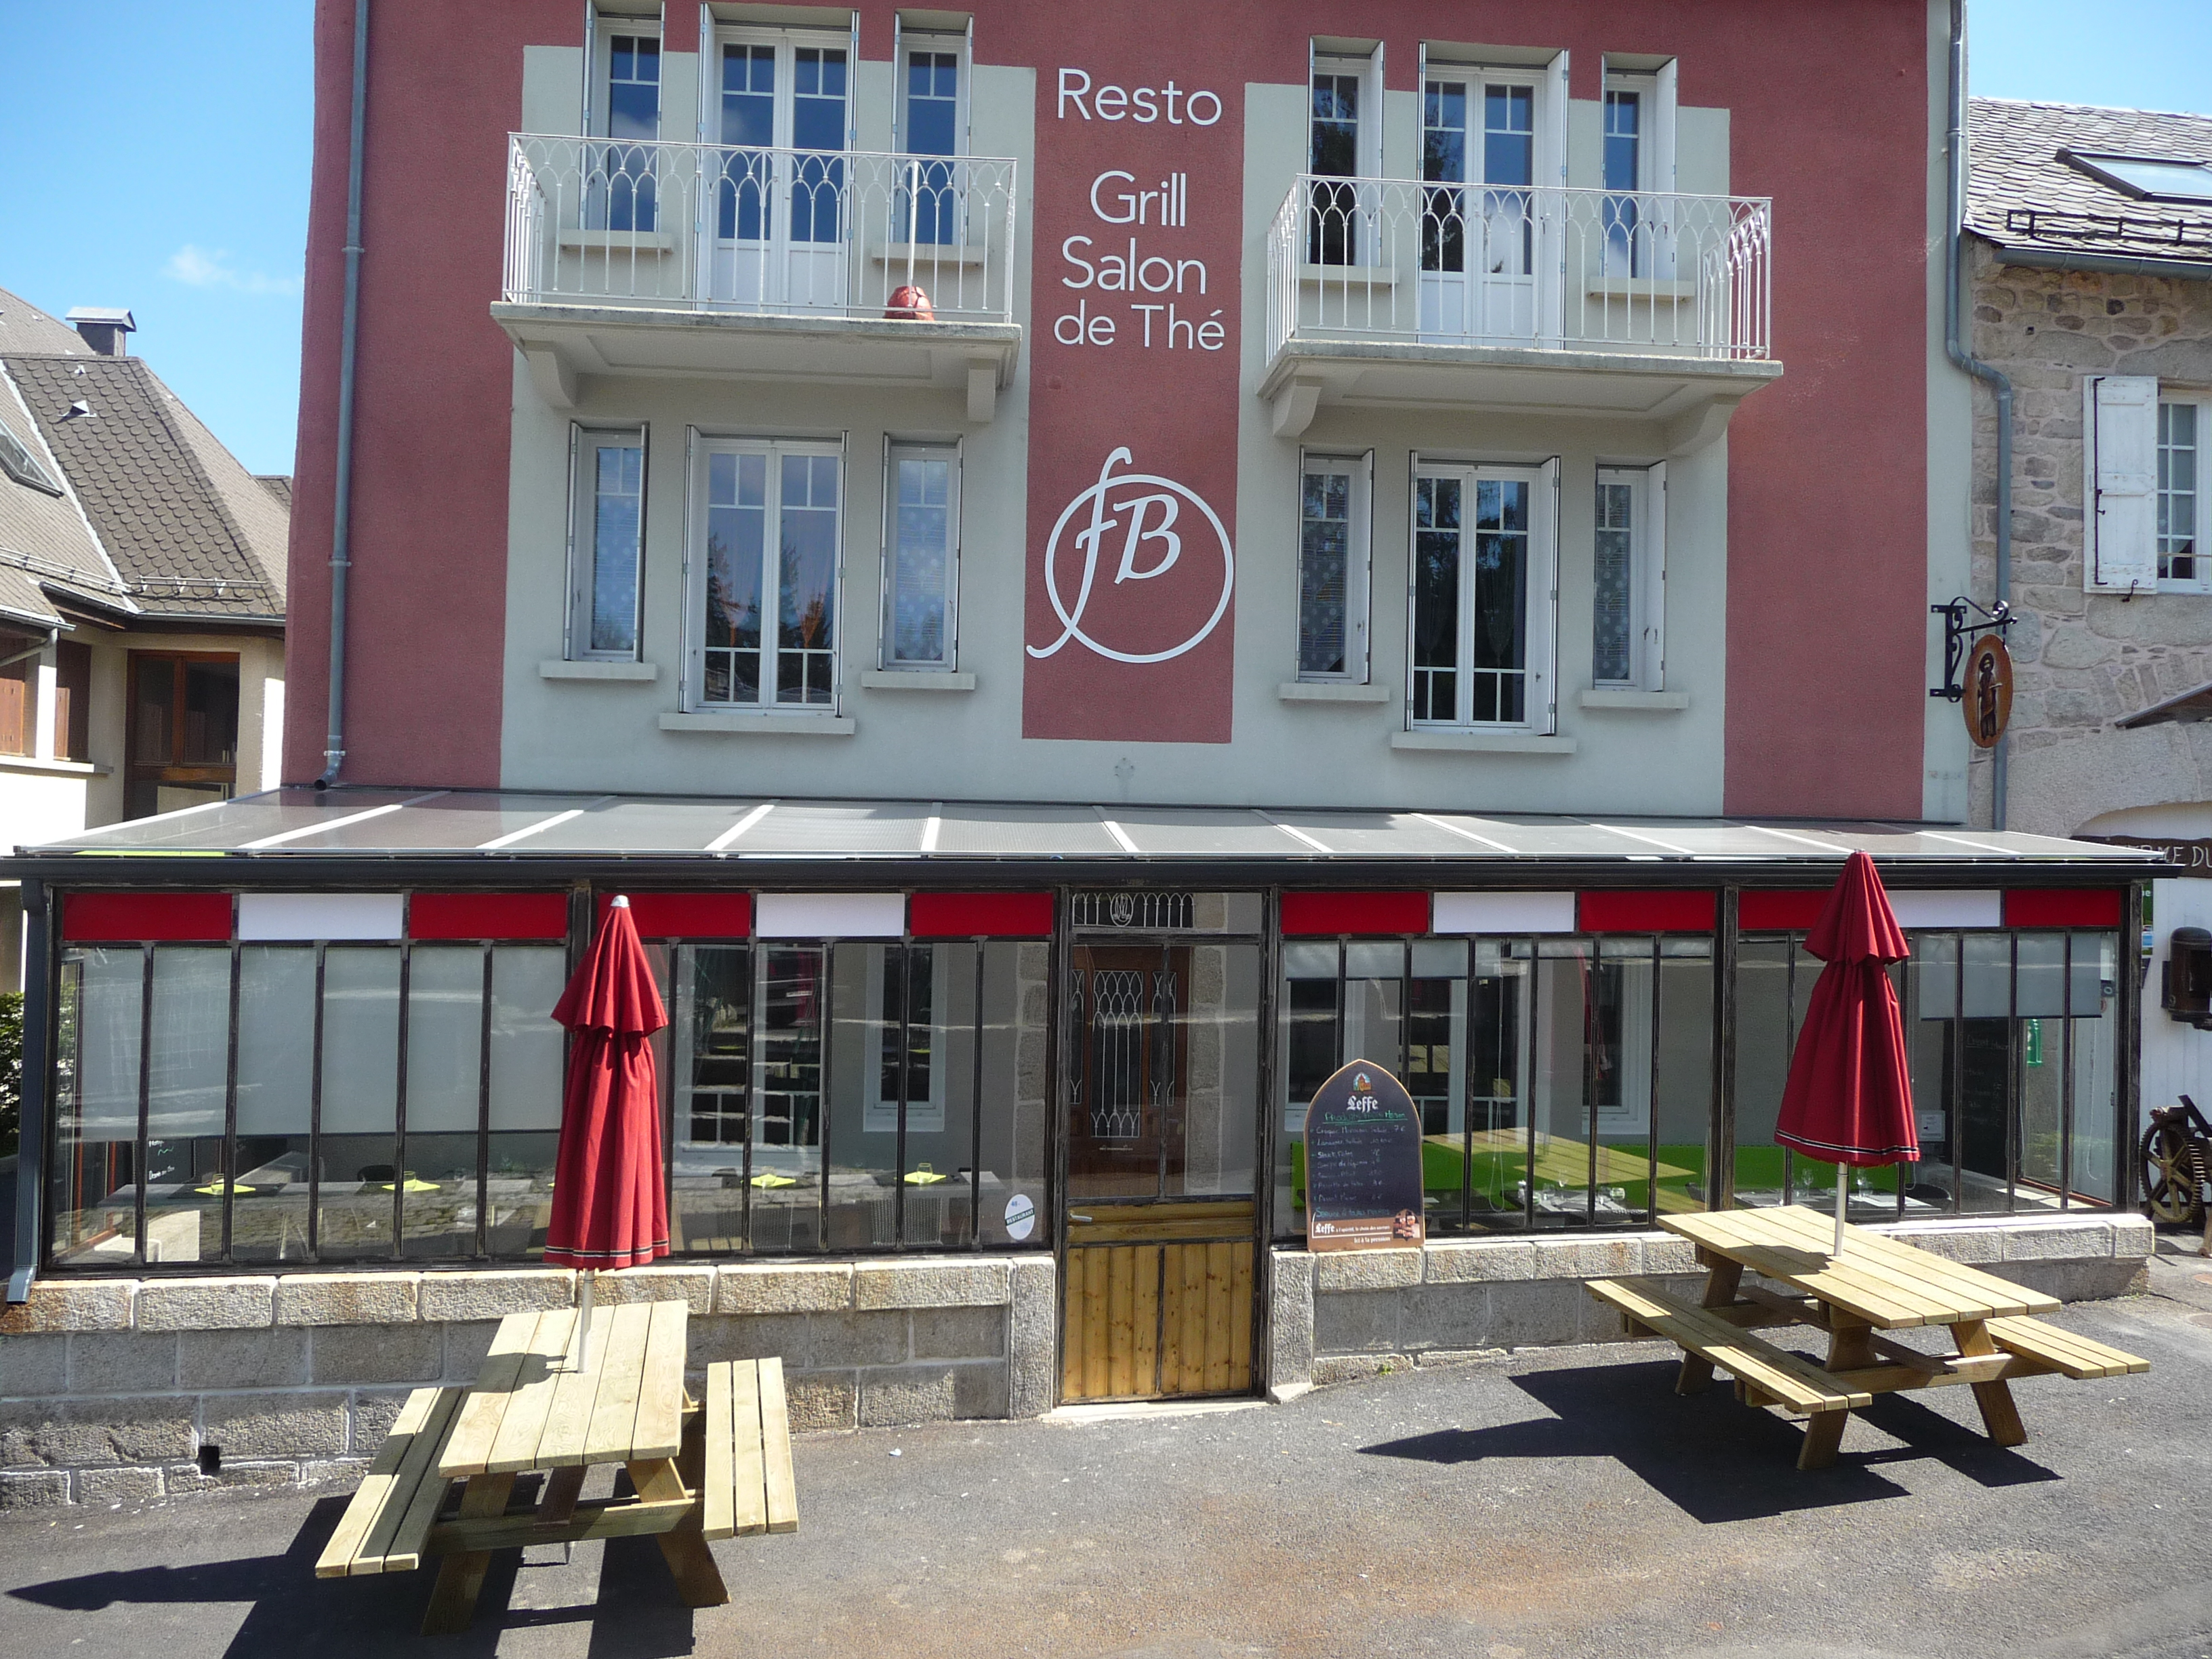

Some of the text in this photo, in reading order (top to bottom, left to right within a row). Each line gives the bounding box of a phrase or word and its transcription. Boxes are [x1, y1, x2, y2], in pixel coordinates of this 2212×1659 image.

[1058, 68, 1222, 125] Resto
[1090, 170, 1186, 226] Grill
[1061, 235, 1206, 294] Salon
[1054, 299, 1225, 350] de Thé
[1346, 1095, 1378, 1113] Leffe
[1315, 1223, 1335, 1234] Leffe
